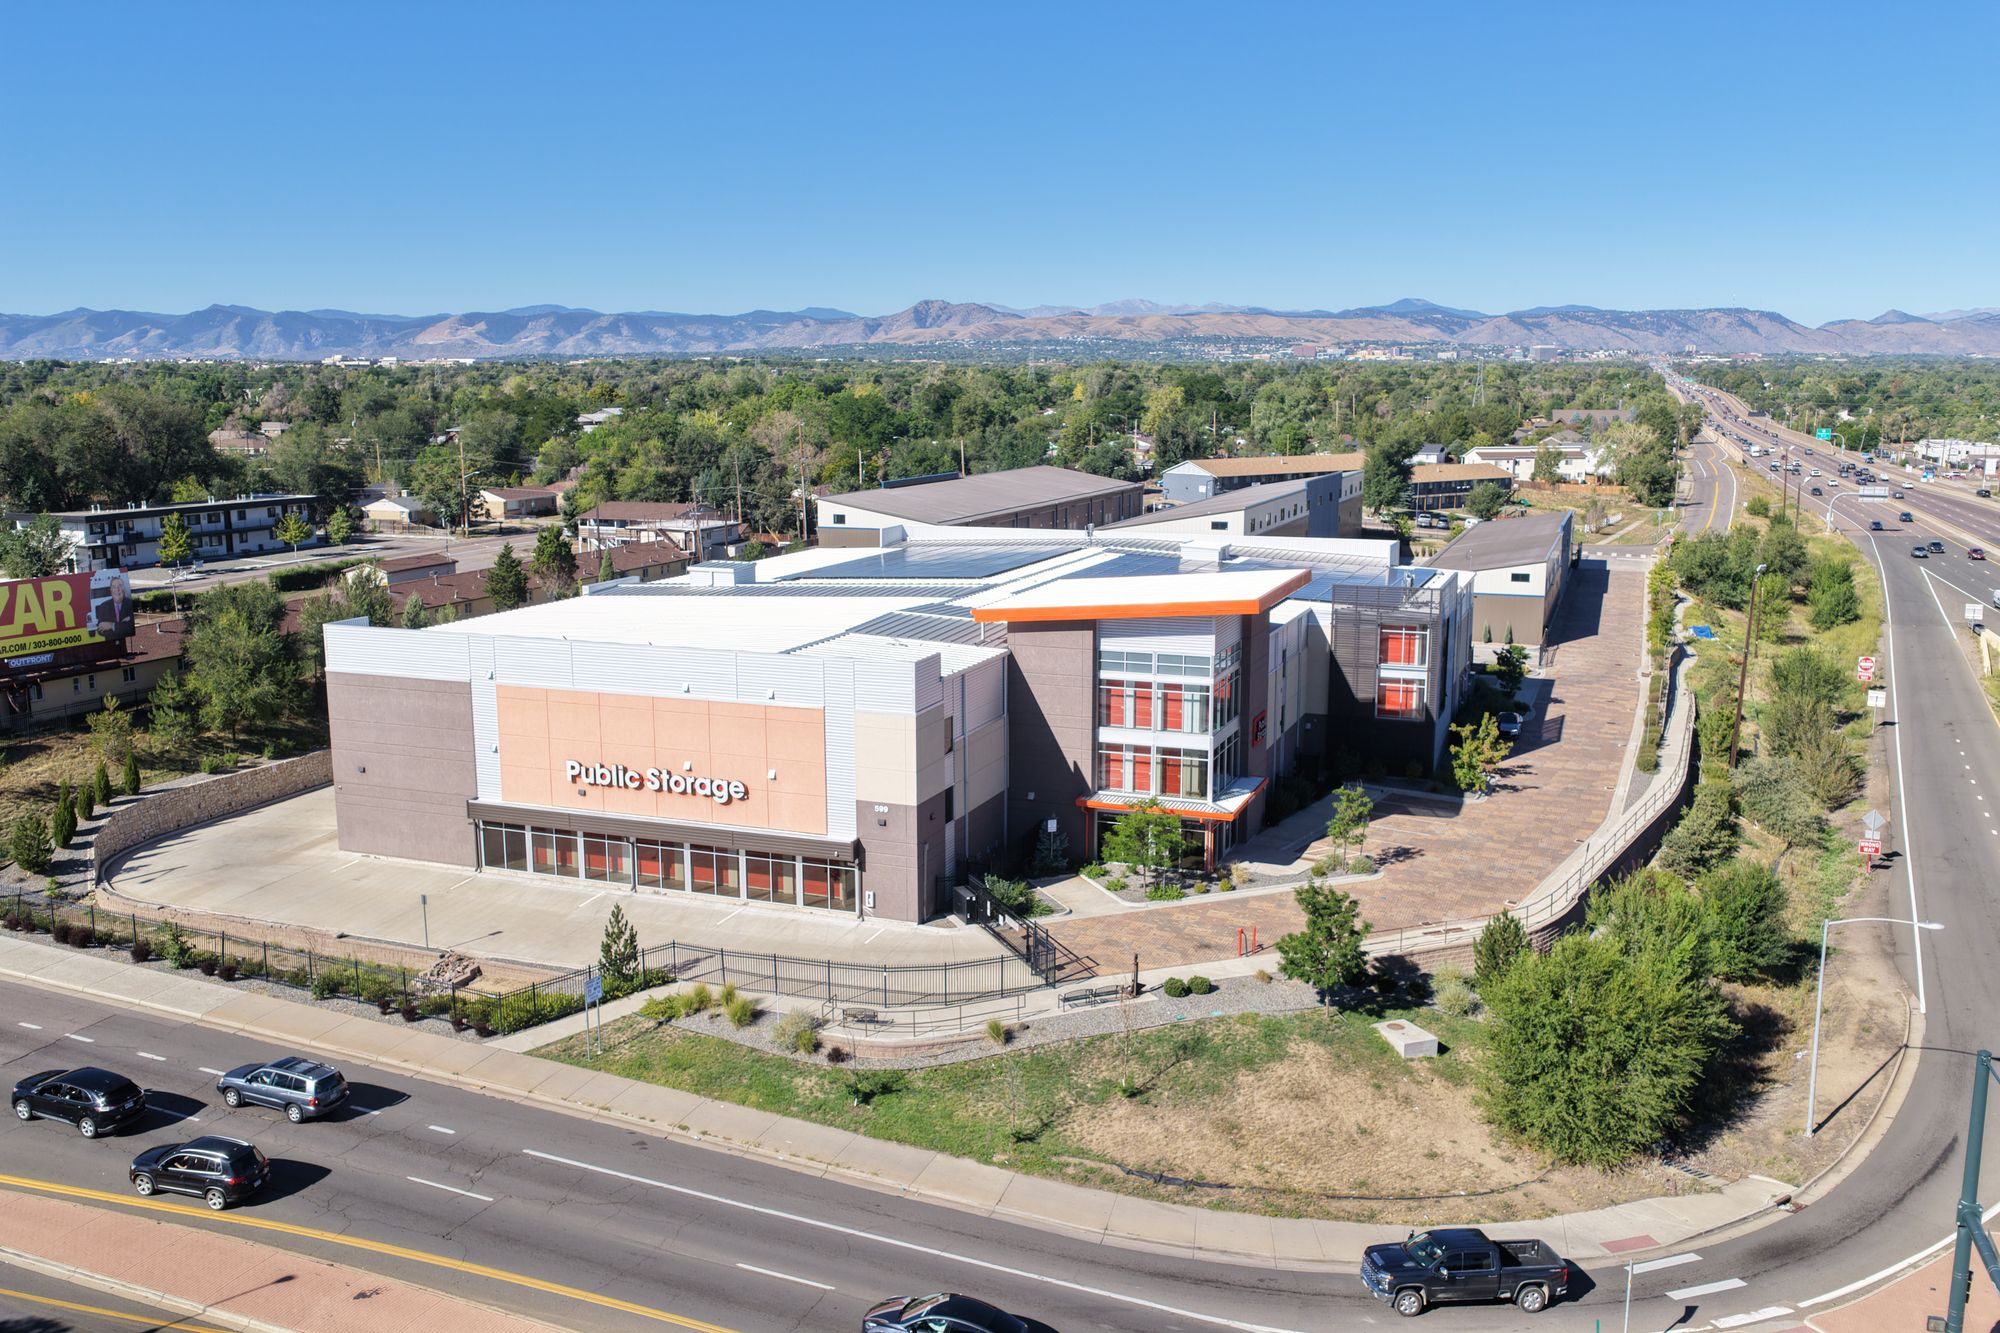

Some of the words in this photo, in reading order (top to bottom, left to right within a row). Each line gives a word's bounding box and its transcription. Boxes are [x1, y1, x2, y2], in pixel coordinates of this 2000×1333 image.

[33, 635, 81, 648] 303-800-0000
[11, 655, 51, 666] OUTFRONT
[566, 760, 642, 789] Public
[874, 805, 889, 813] 599
